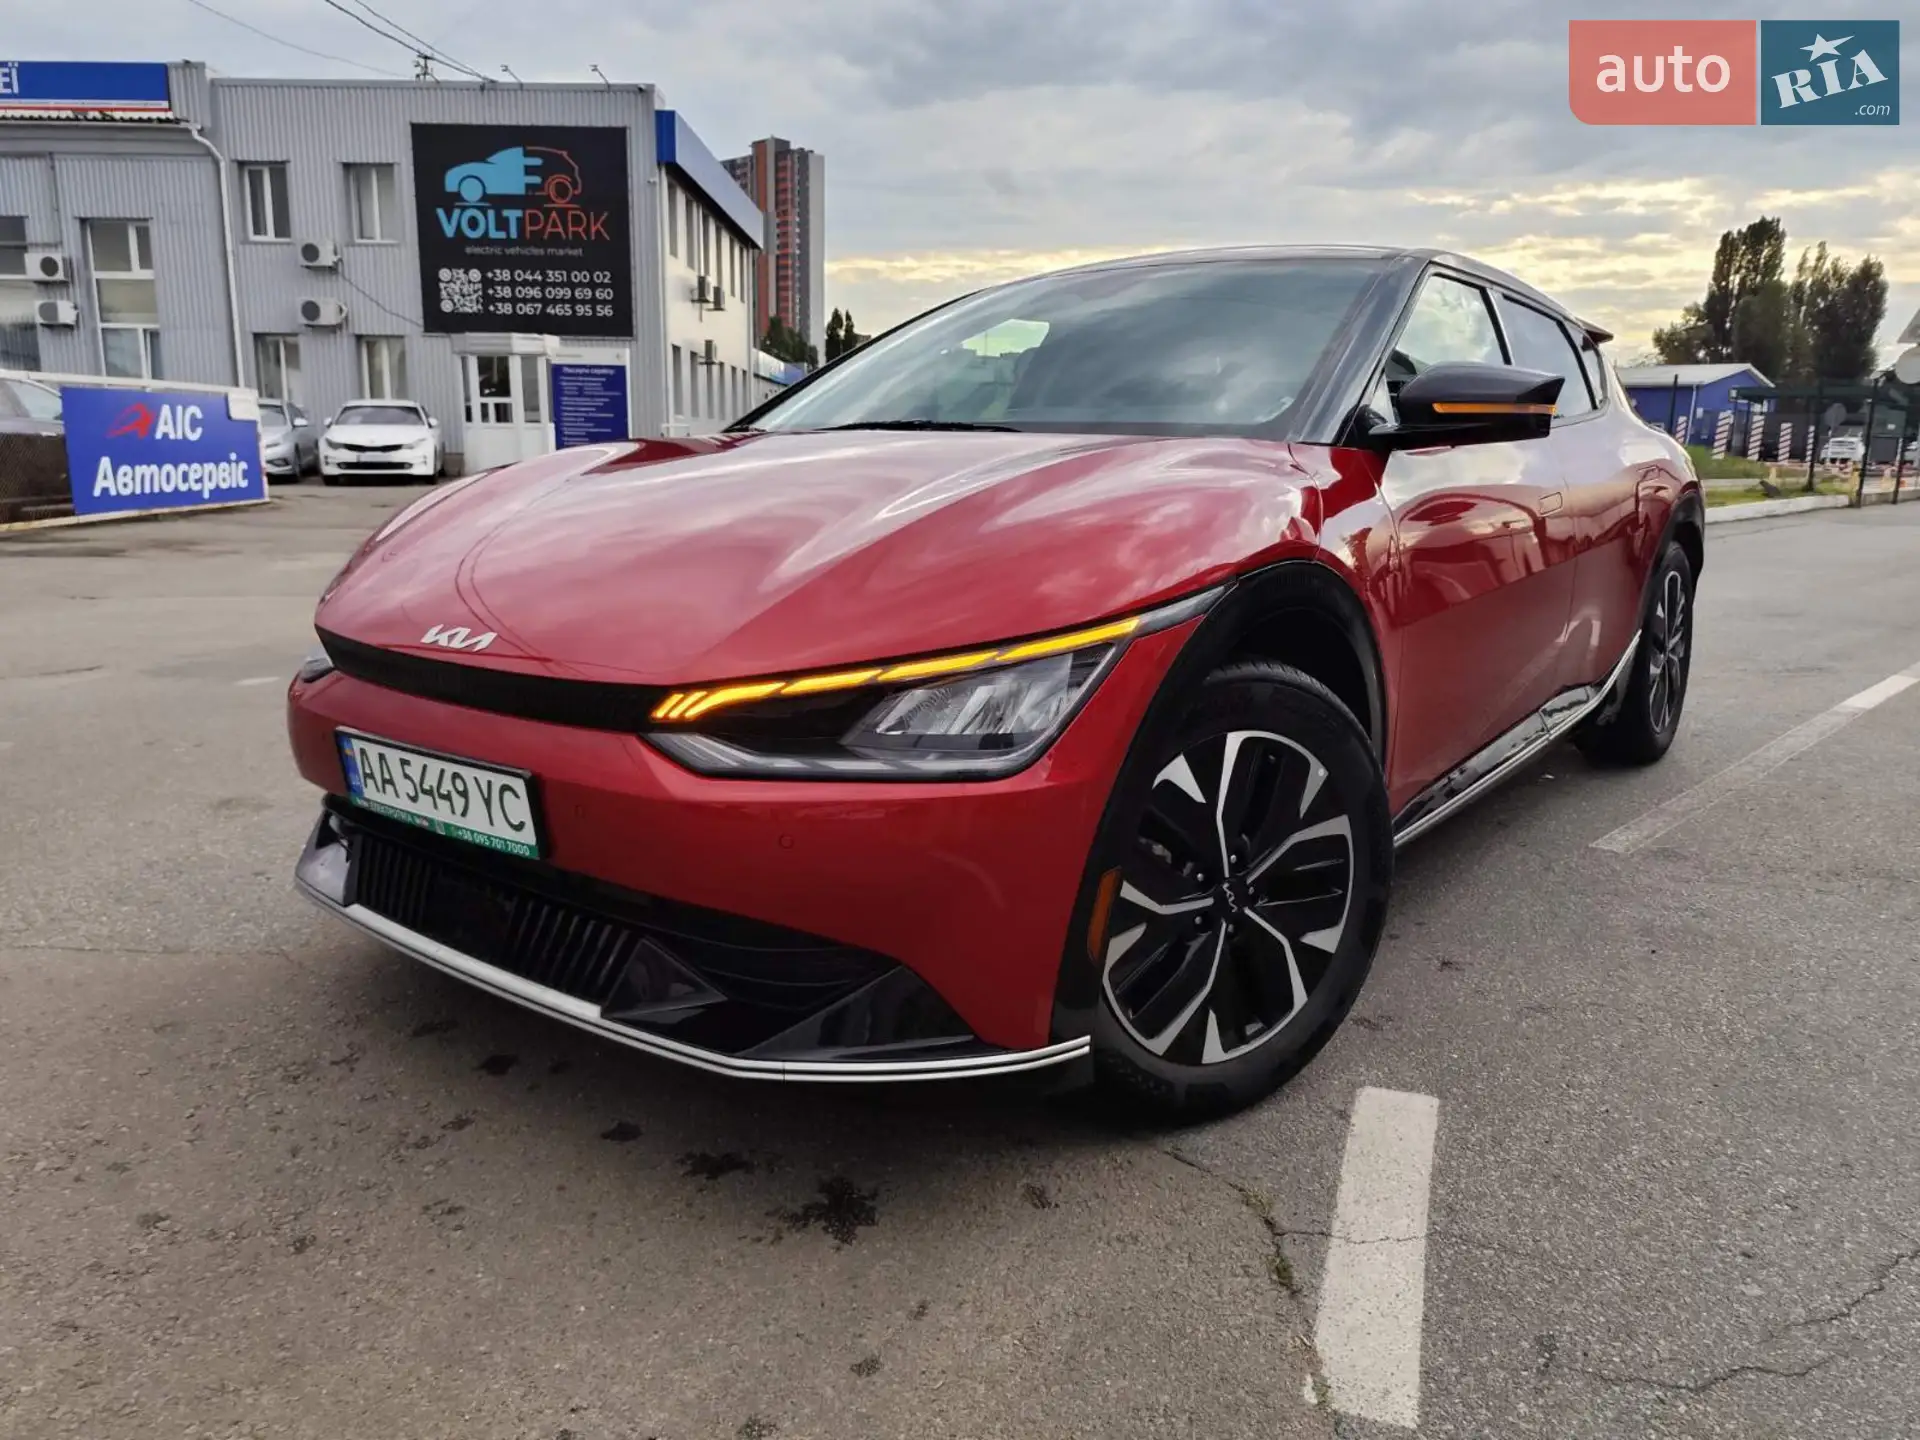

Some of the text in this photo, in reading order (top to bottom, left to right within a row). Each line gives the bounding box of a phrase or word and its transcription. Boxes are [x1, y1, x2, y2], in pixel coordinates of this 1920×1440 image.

[435, 207, 611, 242] VOLTPARK
[465, 244, 583, 258] electric vehicles market
[486, 269, 612, 284] +38 044 351 00 02
[487, 285, 614, 300] +38 096 099 69 60
[488, 302, 614, 317] +38 067 465 95 56
[92, 452, 248, 500] Автосервіс
[420, 623, 498, 653] KIA
